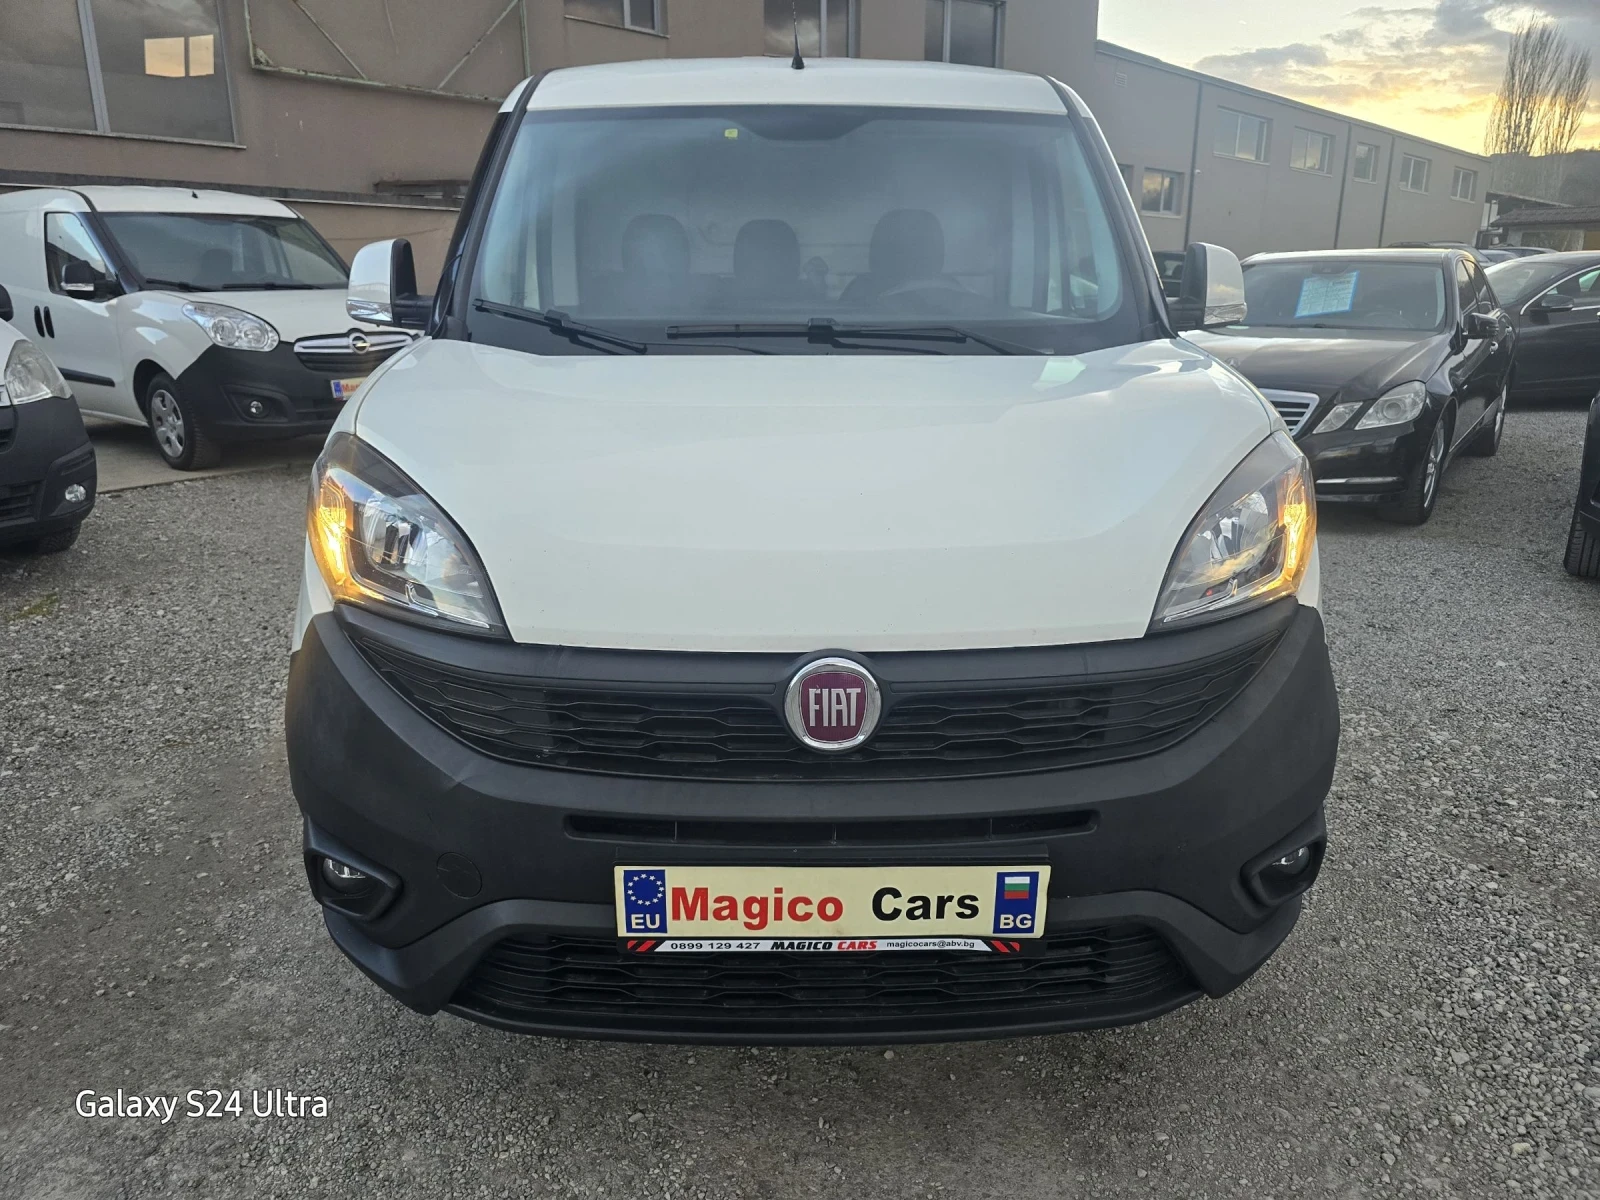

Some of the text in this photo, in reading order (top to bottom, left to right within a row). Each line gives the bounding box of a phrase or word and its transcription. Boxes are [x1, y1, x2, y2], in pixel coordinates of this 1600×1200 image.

[808, 688, 861, 727] FIAT
[671, 887, 980, 931] Magico Cars
[631, 913, 661, 929] EU
[999, 914, 1032, 929] BG
[670, 940, 975, 951] 0899 129 427 MAGICO CARS magicocars@abv.bg
